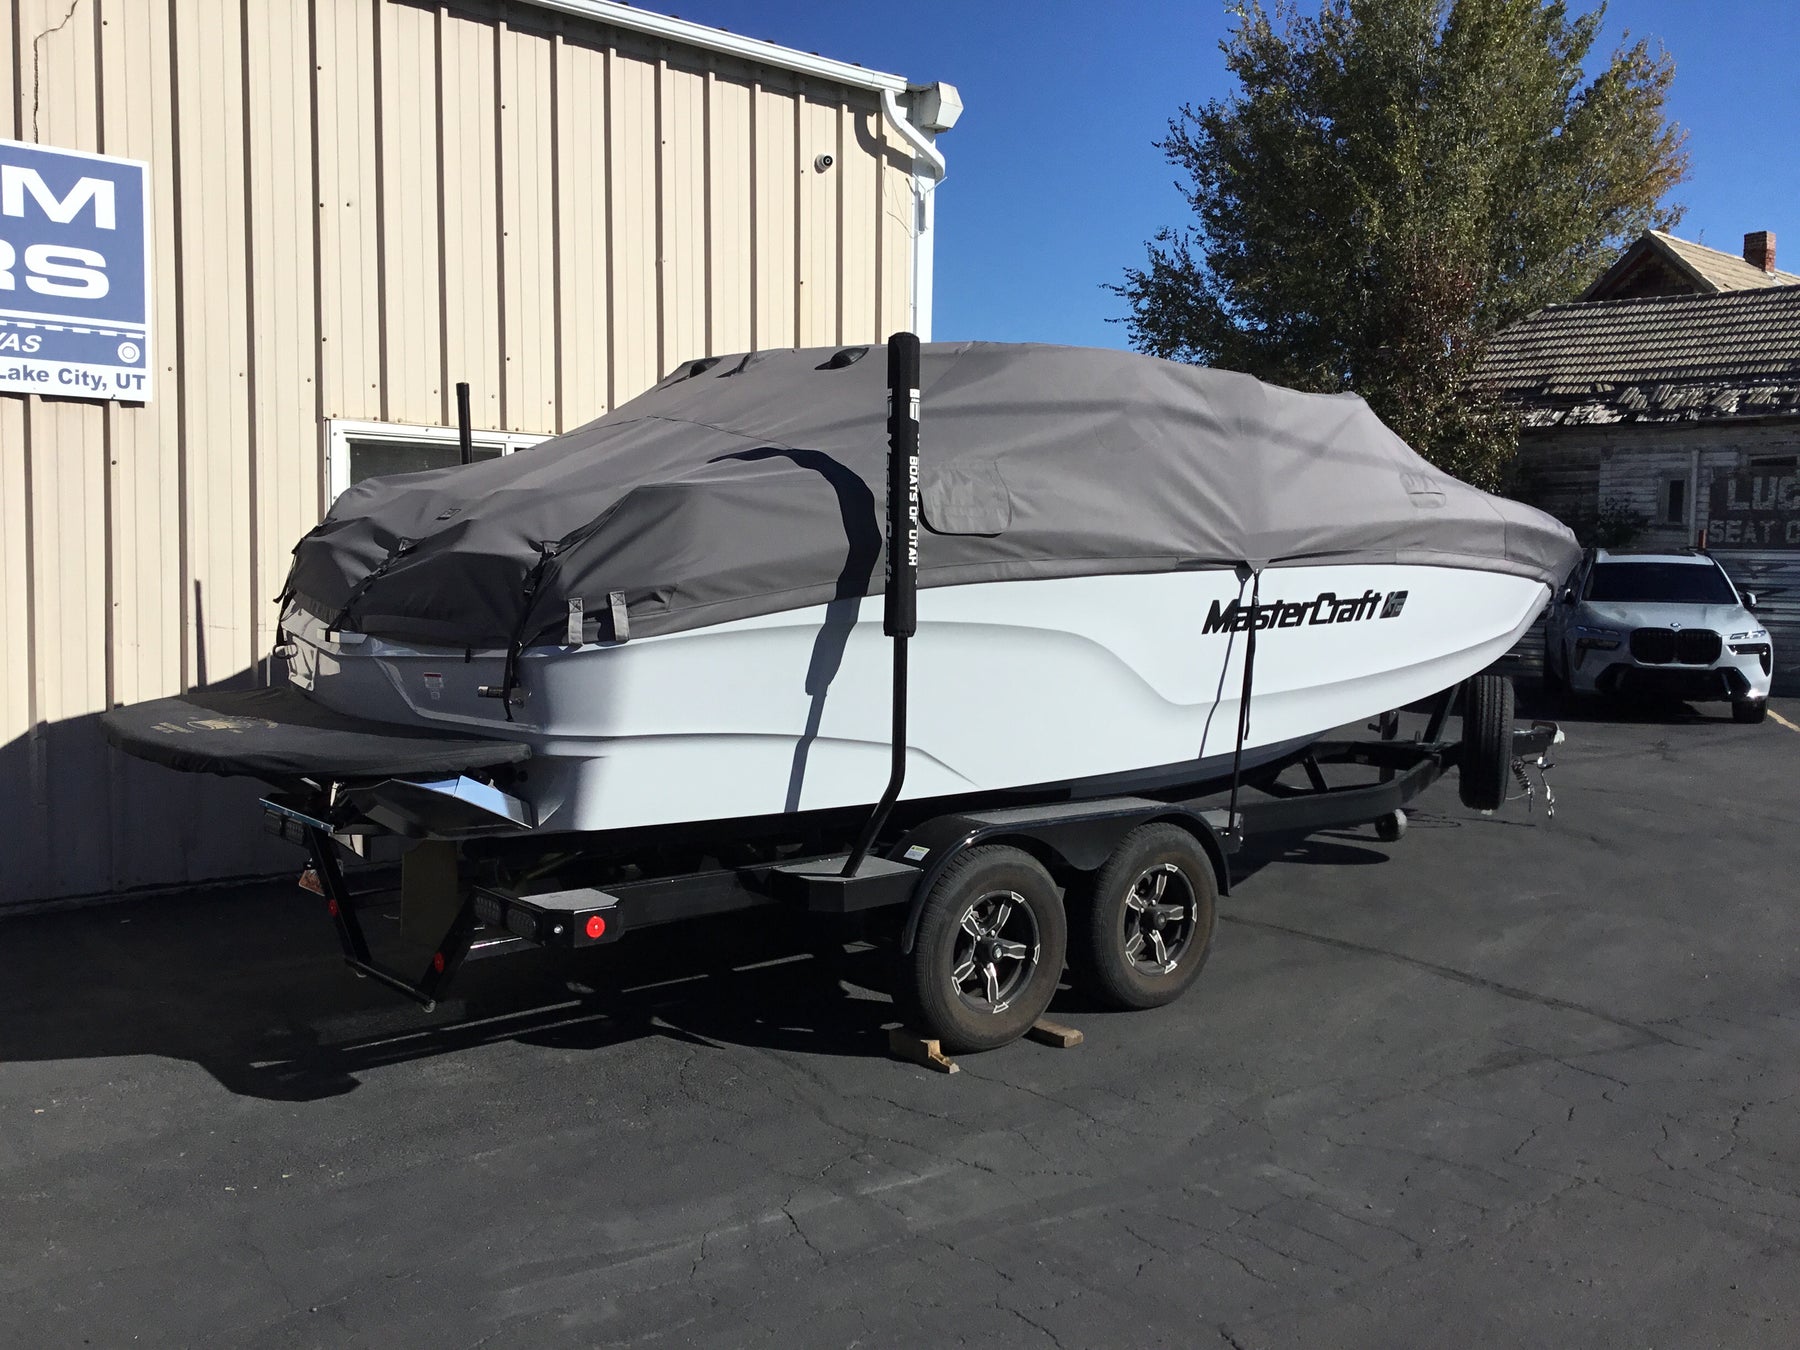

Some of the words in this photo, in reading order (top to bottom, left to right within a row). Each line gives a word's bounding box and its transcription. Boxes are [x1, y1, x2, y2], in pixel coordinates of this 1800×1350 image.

[0, 239, 110, 299] S
[58, 368, 107, 391] City,
[116, 373, 146, 390] UT
[909, 456, 919, 501] BOATS
[908, 507, 918, 525] OF
[1709, 520, 1776, 543] SEAT
[908, 529, 918, 566] UTAH
[1201, 590, 1381, 634] MasterCraft
